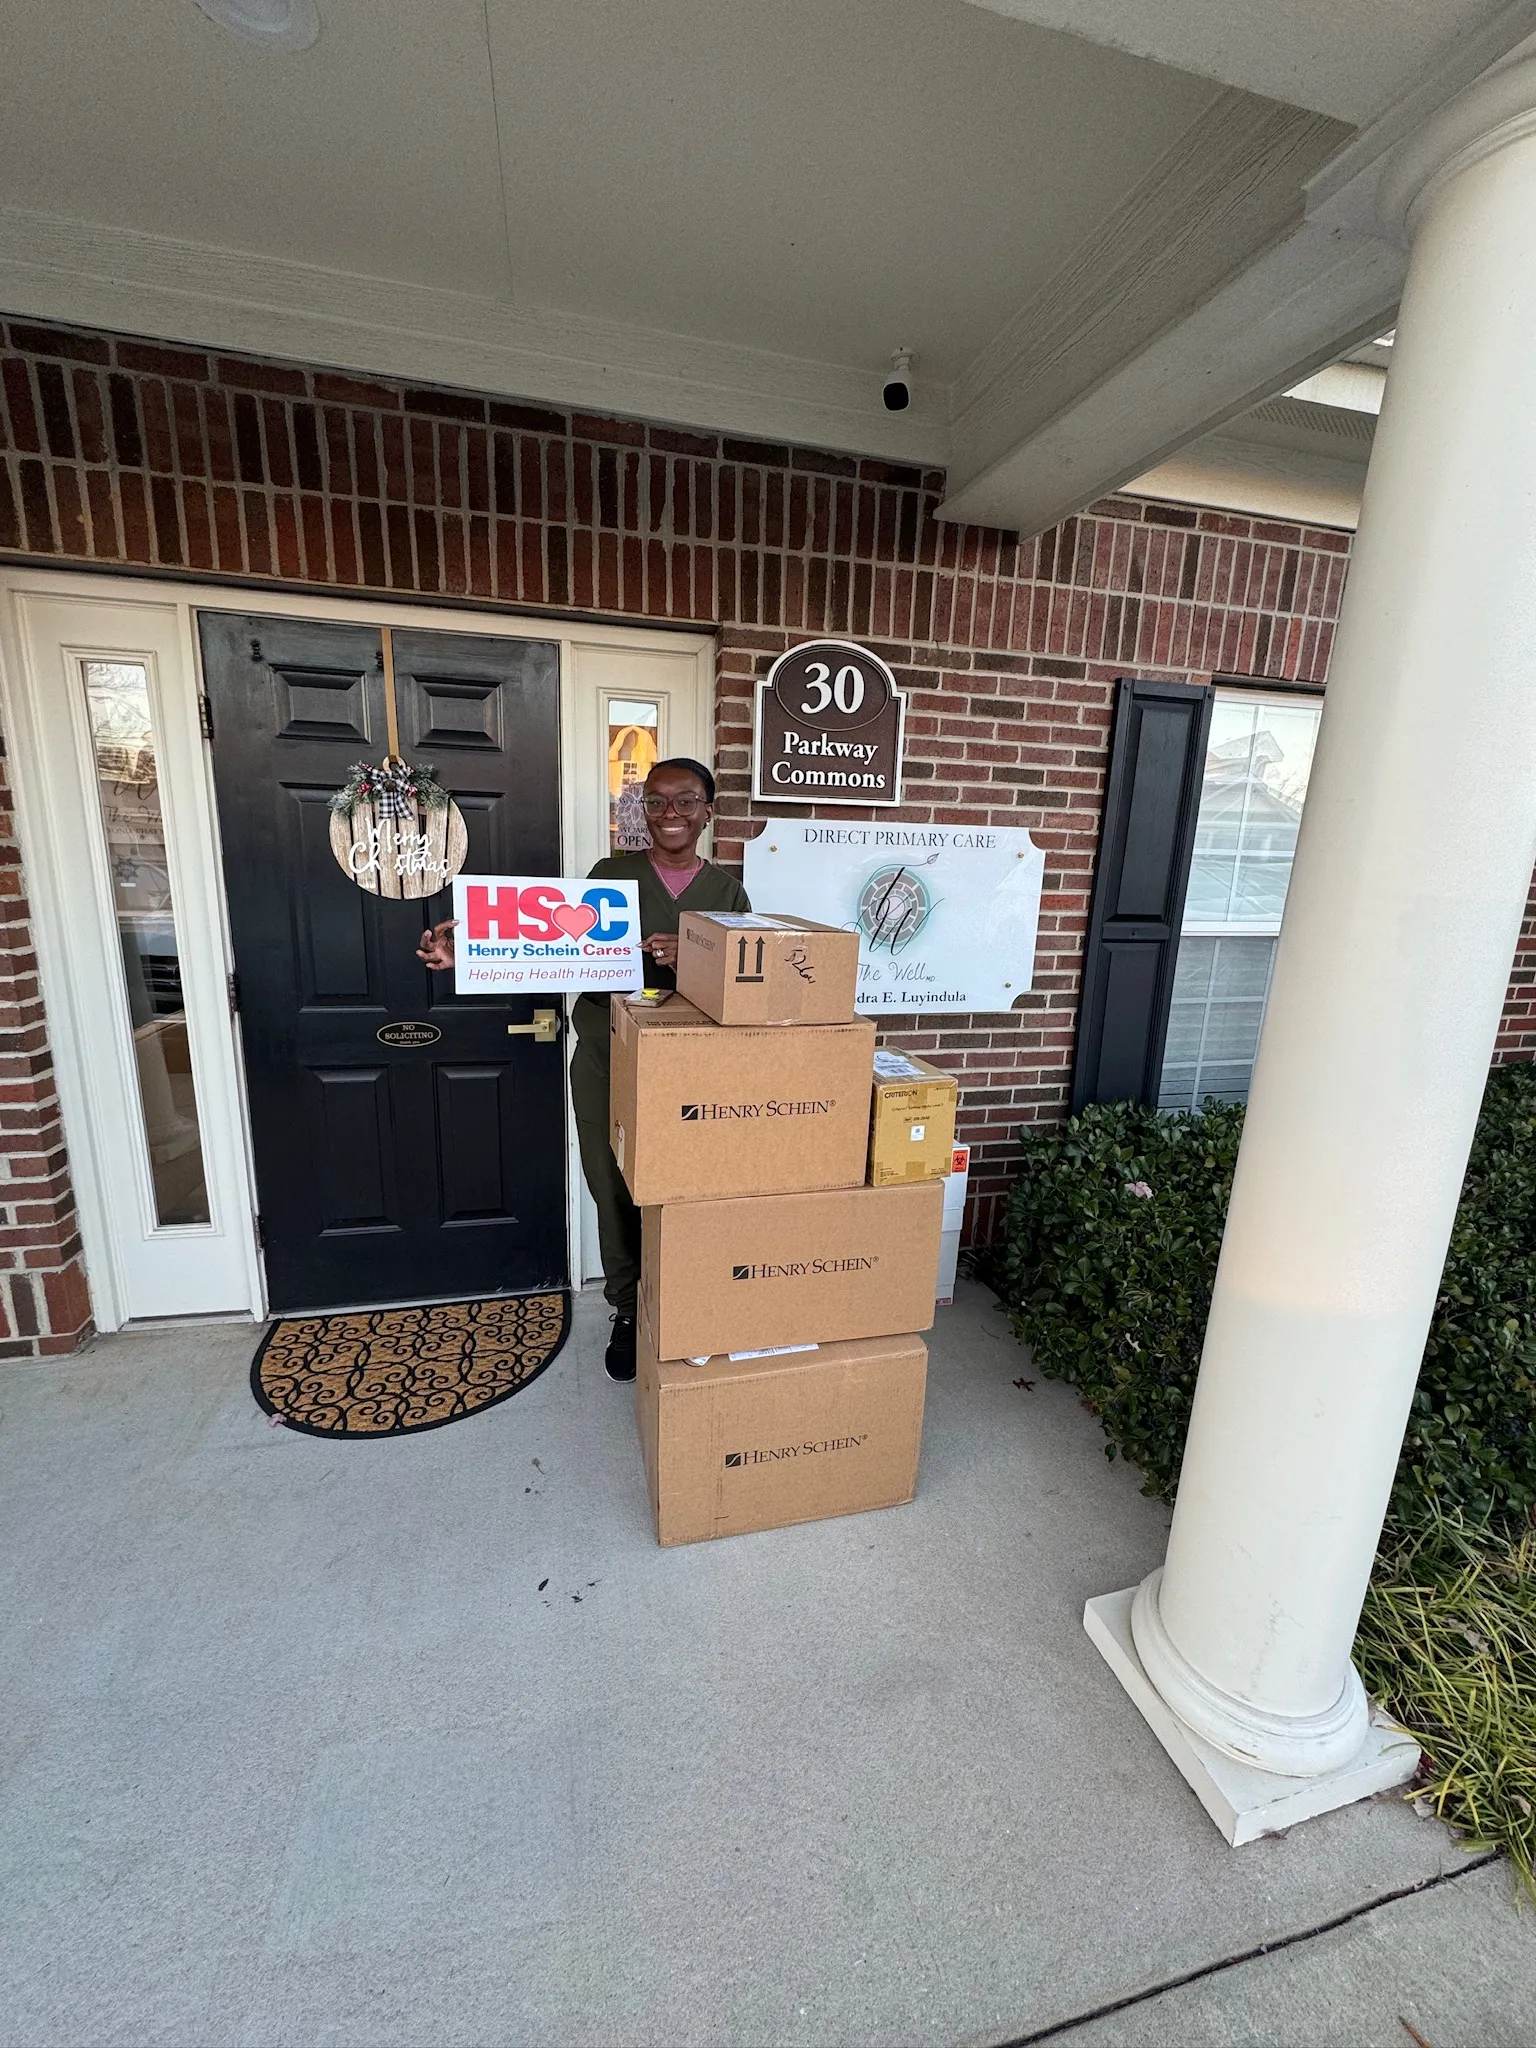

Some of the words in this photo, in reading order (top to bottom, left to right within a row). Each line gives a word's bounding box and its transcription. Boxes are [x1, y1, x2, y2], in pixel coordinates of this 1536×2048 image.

[801, 662, 865, 714] 30
[783, 731, 878, 766] Parkway
[771, 761, 886, 789] Commons
[364, 817, 432, 859] Merry
[617, 834, 651, 847] OPEN
[804, 828, 870, 845] DIRECT
[875, 830, 949, 848] PRIMARY
[953, 833, 997, 849] CARE
[348, 841, 452, 878] Chstmas
[468, 943, 518, 959] Henry
[522, 943, 580, 956] Schein
[583, 943, 632, 956] Cares
[468, 968, 524, 982] Helping
[529, 967, 574, 979] Health
[579, 967, 633, 980] Happen
[857, 962, 882, 982] The
[888, 961, 926, 982] Well
[854, 992, 882, 1004] dra
[882, 992, 897, 1004] E.
[901, 990, 967, 1007] Luyindula
[384, 1031, 434, 1040] SOLICITING
[884, 1089, 918, 1098] CRITERION
[700, 1103, 764, 1120] HENRY
[750, 1263, 810, 1279] HENRY
[743, 1445, 801, 1466] HENRY
